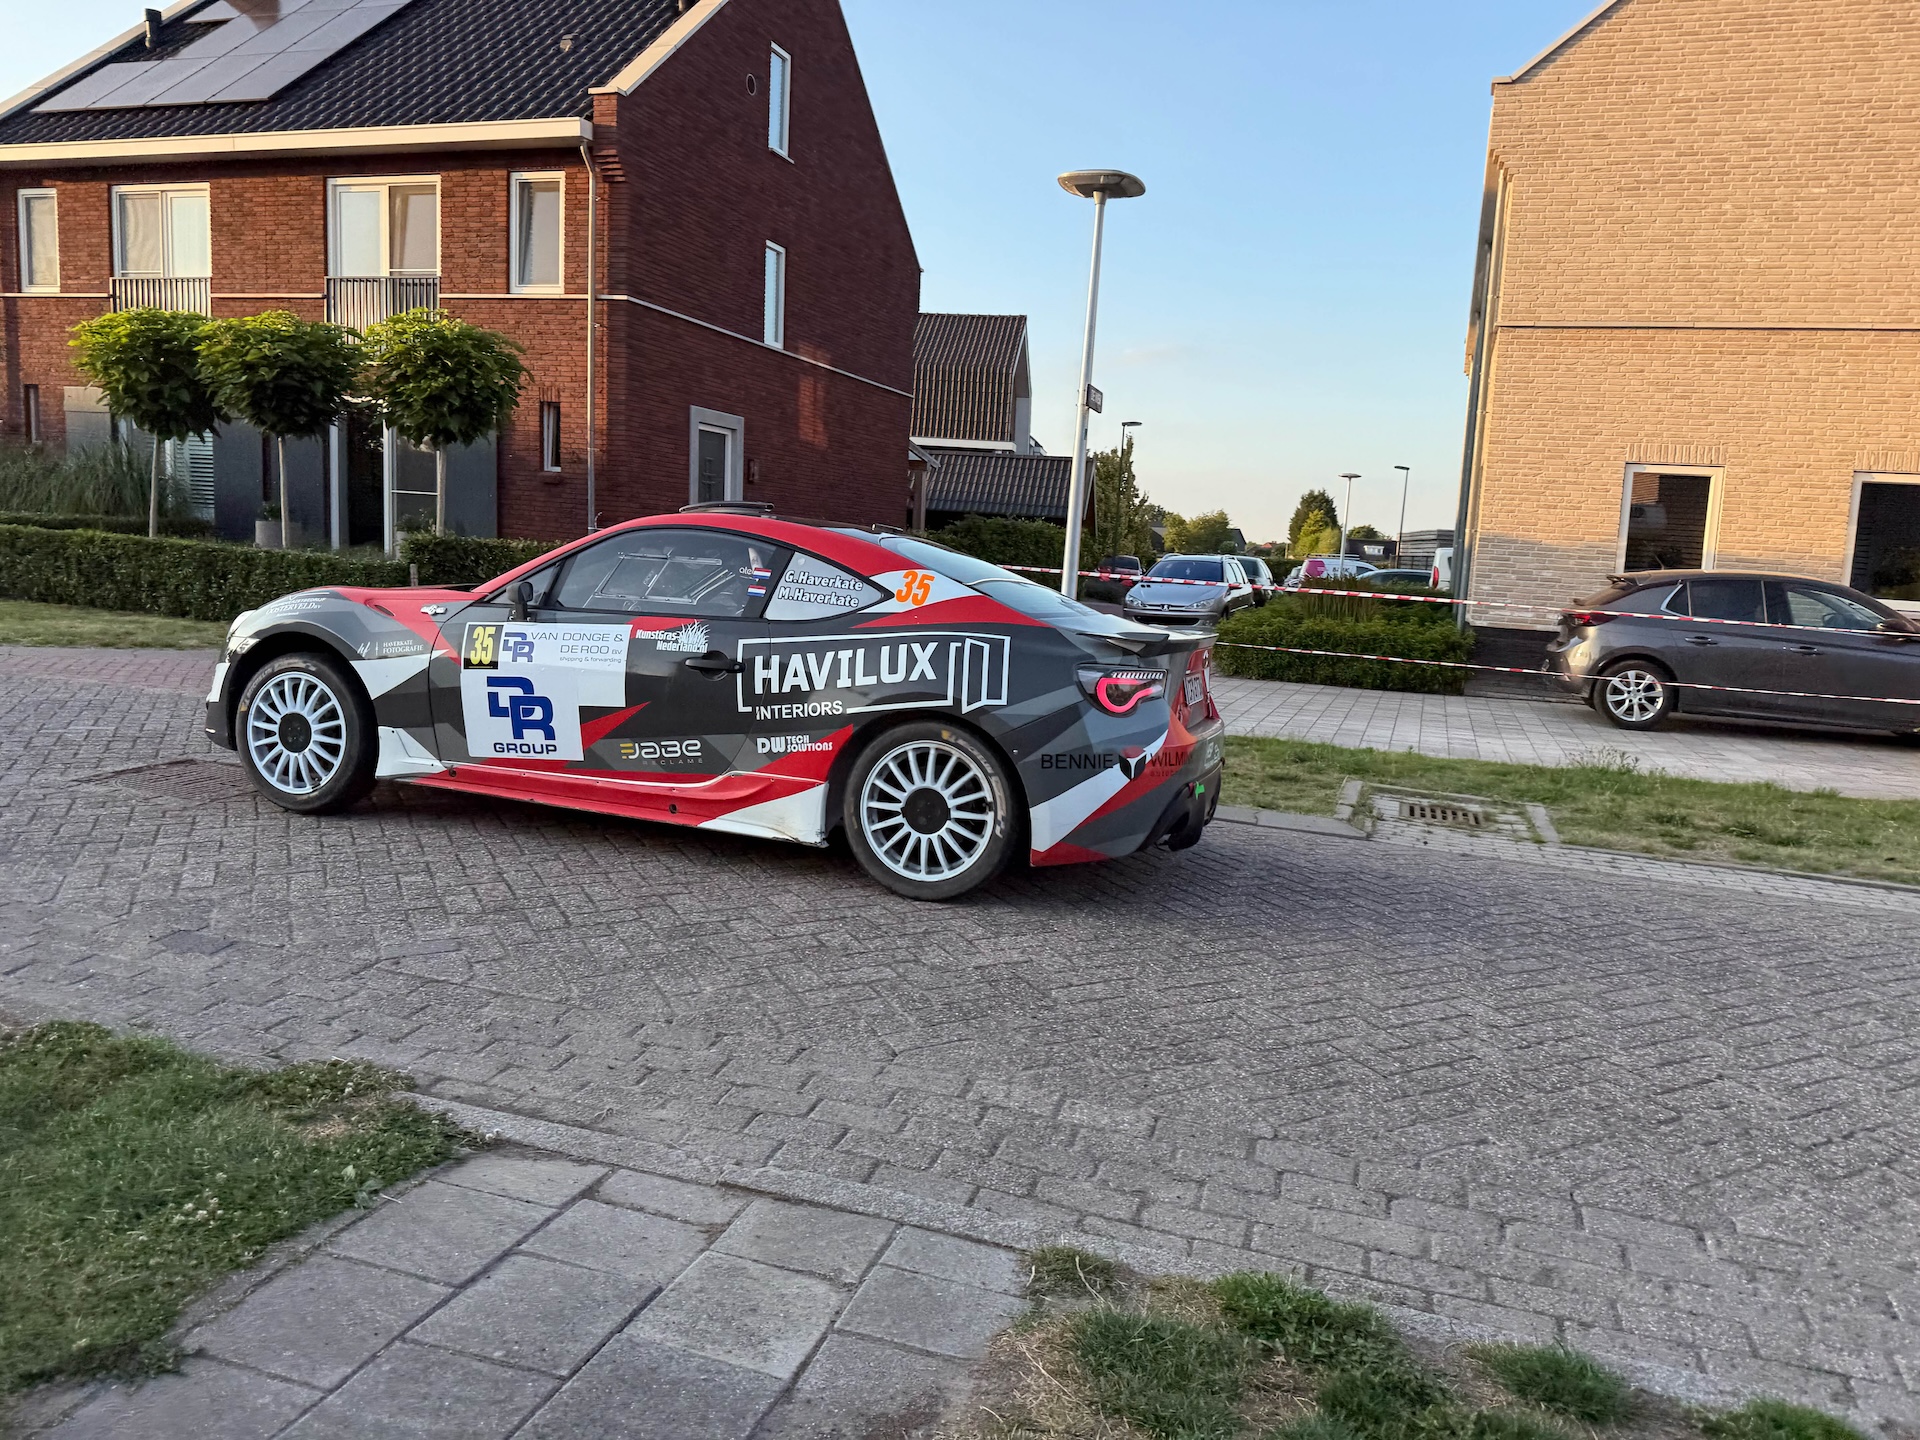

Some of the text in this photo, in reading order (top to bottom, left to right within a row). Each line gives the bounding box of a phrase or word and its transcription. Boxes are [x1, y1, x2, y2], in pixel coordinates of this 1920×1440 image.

[784, 570, 863, 591] G.Haverkate
[895, 571, 935, 606] 35
[777, 586, 859, 608] M.Haverkate
[383, 639, 413, 648] HAVERKATE
[470, 626, 497, 665] 35
[531, 632, 624, 642] VAN DONGE &
[382, 644, 424, 654] FOTOGRAFIE
[754, 642, 939, 695] HAVILUX
[755, 701, 844, 721] INTERIORS
[756, 736, 786, 754] DW
[786, 734, 810, 744] TECH
[786, 742, 834, 753] SOLUTIONS
[493, 742, 558, 755] GROUP
[1041, 753, 1114, 770] BENNIE
